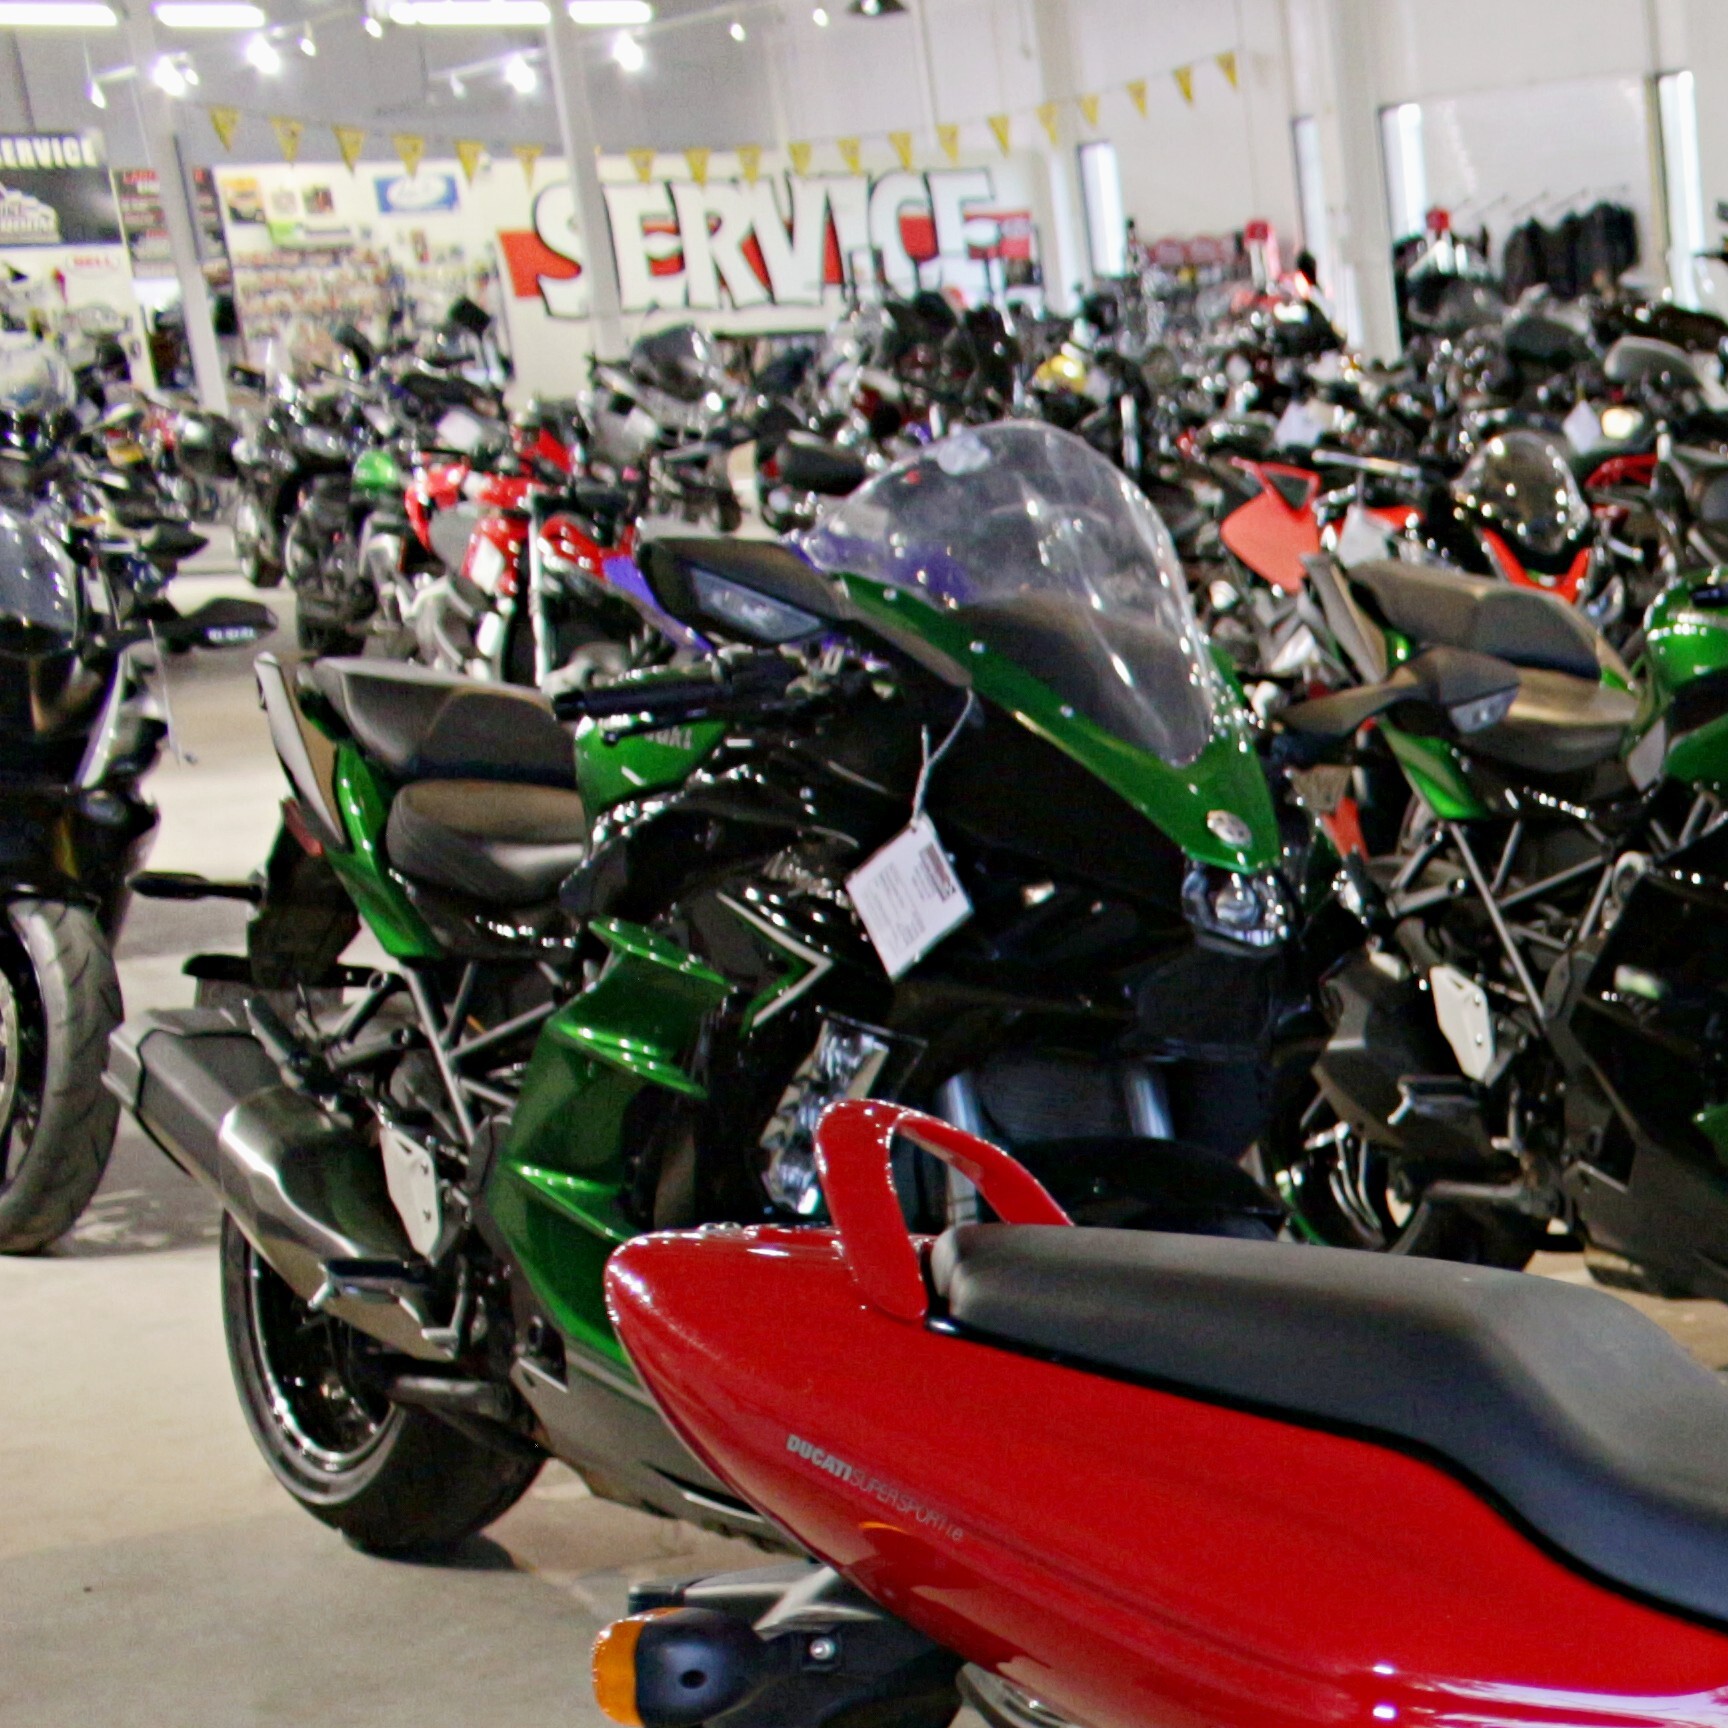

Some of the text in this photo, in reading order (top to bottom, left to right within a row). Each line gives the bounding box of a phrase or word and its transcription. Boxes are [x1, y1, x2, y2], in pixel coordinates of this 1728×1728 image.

[0, 136, 98, 168] ERVICE
[533, 168, 997, 318] SERVICE
[786, 1434, 852, 1481] DUCATI
